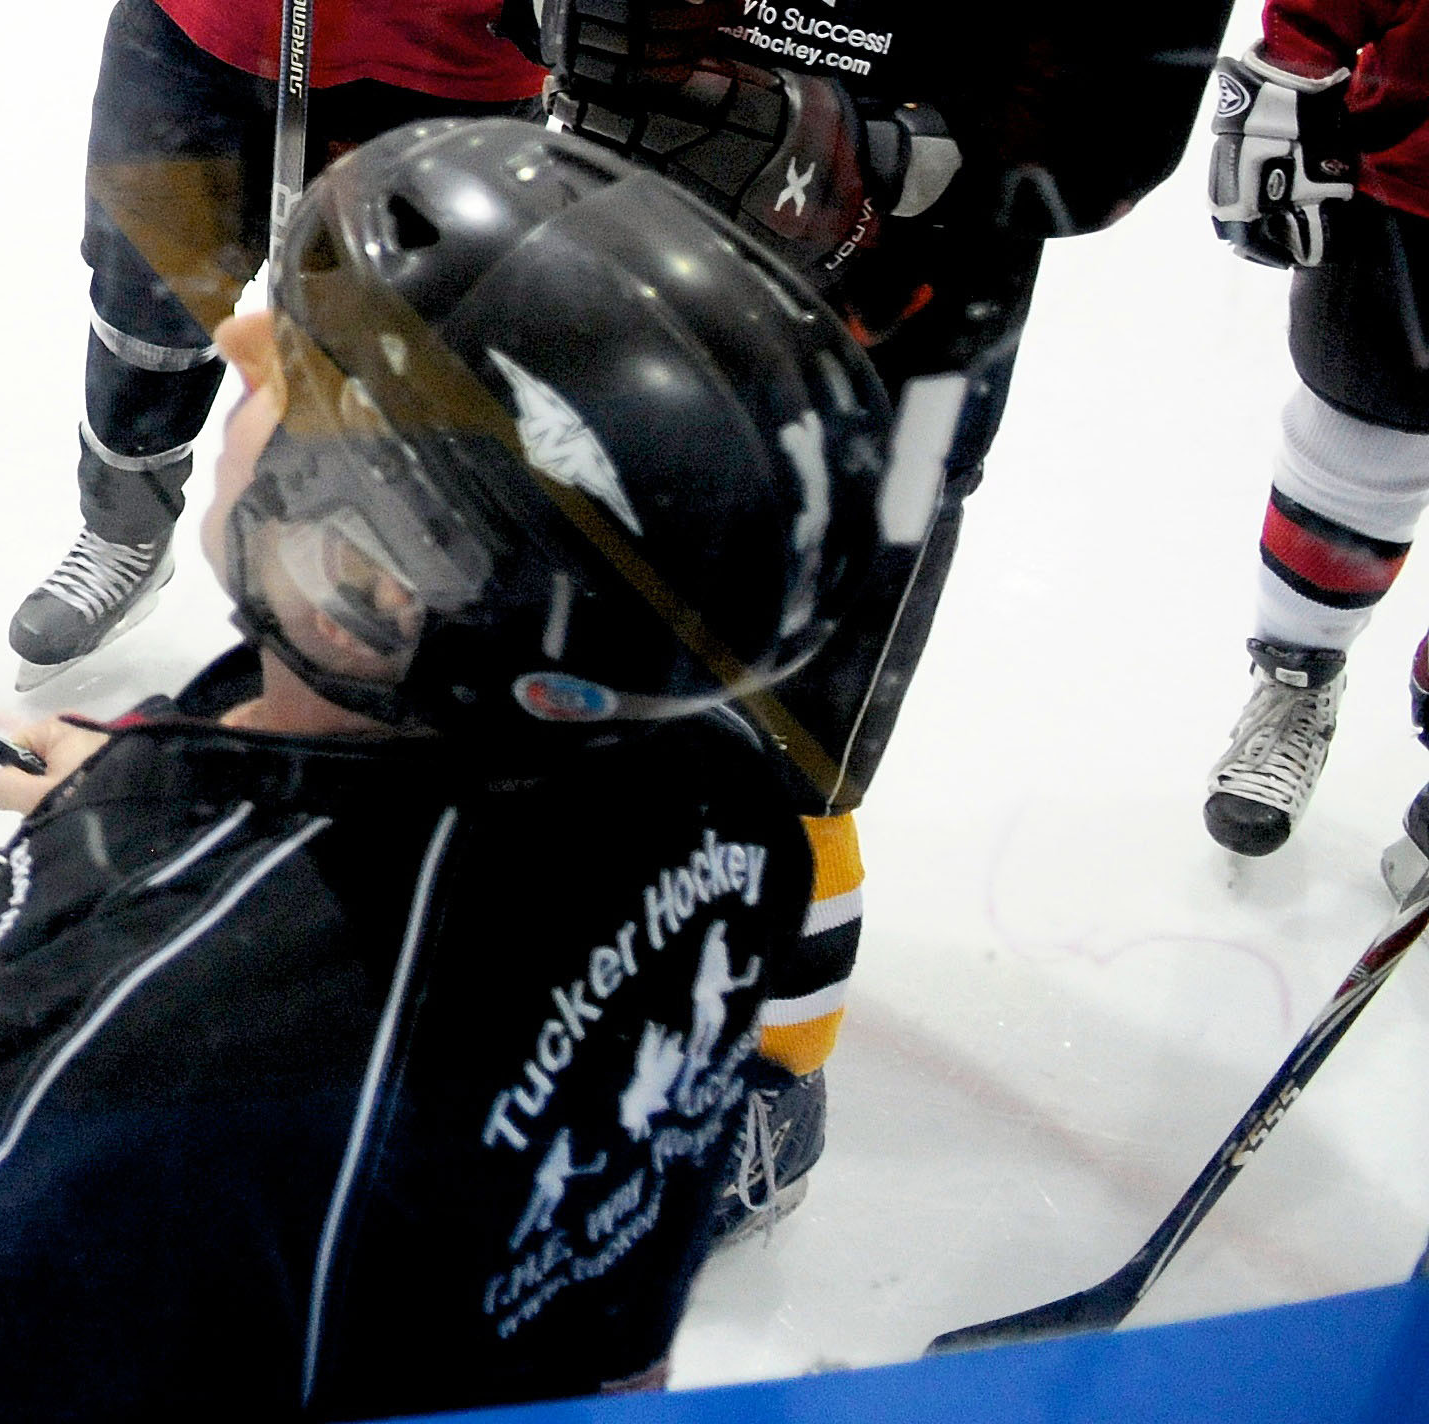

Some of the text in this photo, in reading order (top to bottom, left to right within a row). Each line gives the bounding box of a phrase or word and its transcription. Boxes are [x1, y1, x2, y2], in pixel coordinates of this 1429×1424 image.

[781, 7, 893, 55] Success!
[482, 920, 637, 1152] Tucker
[643, 828, 767, 951] Hockey
